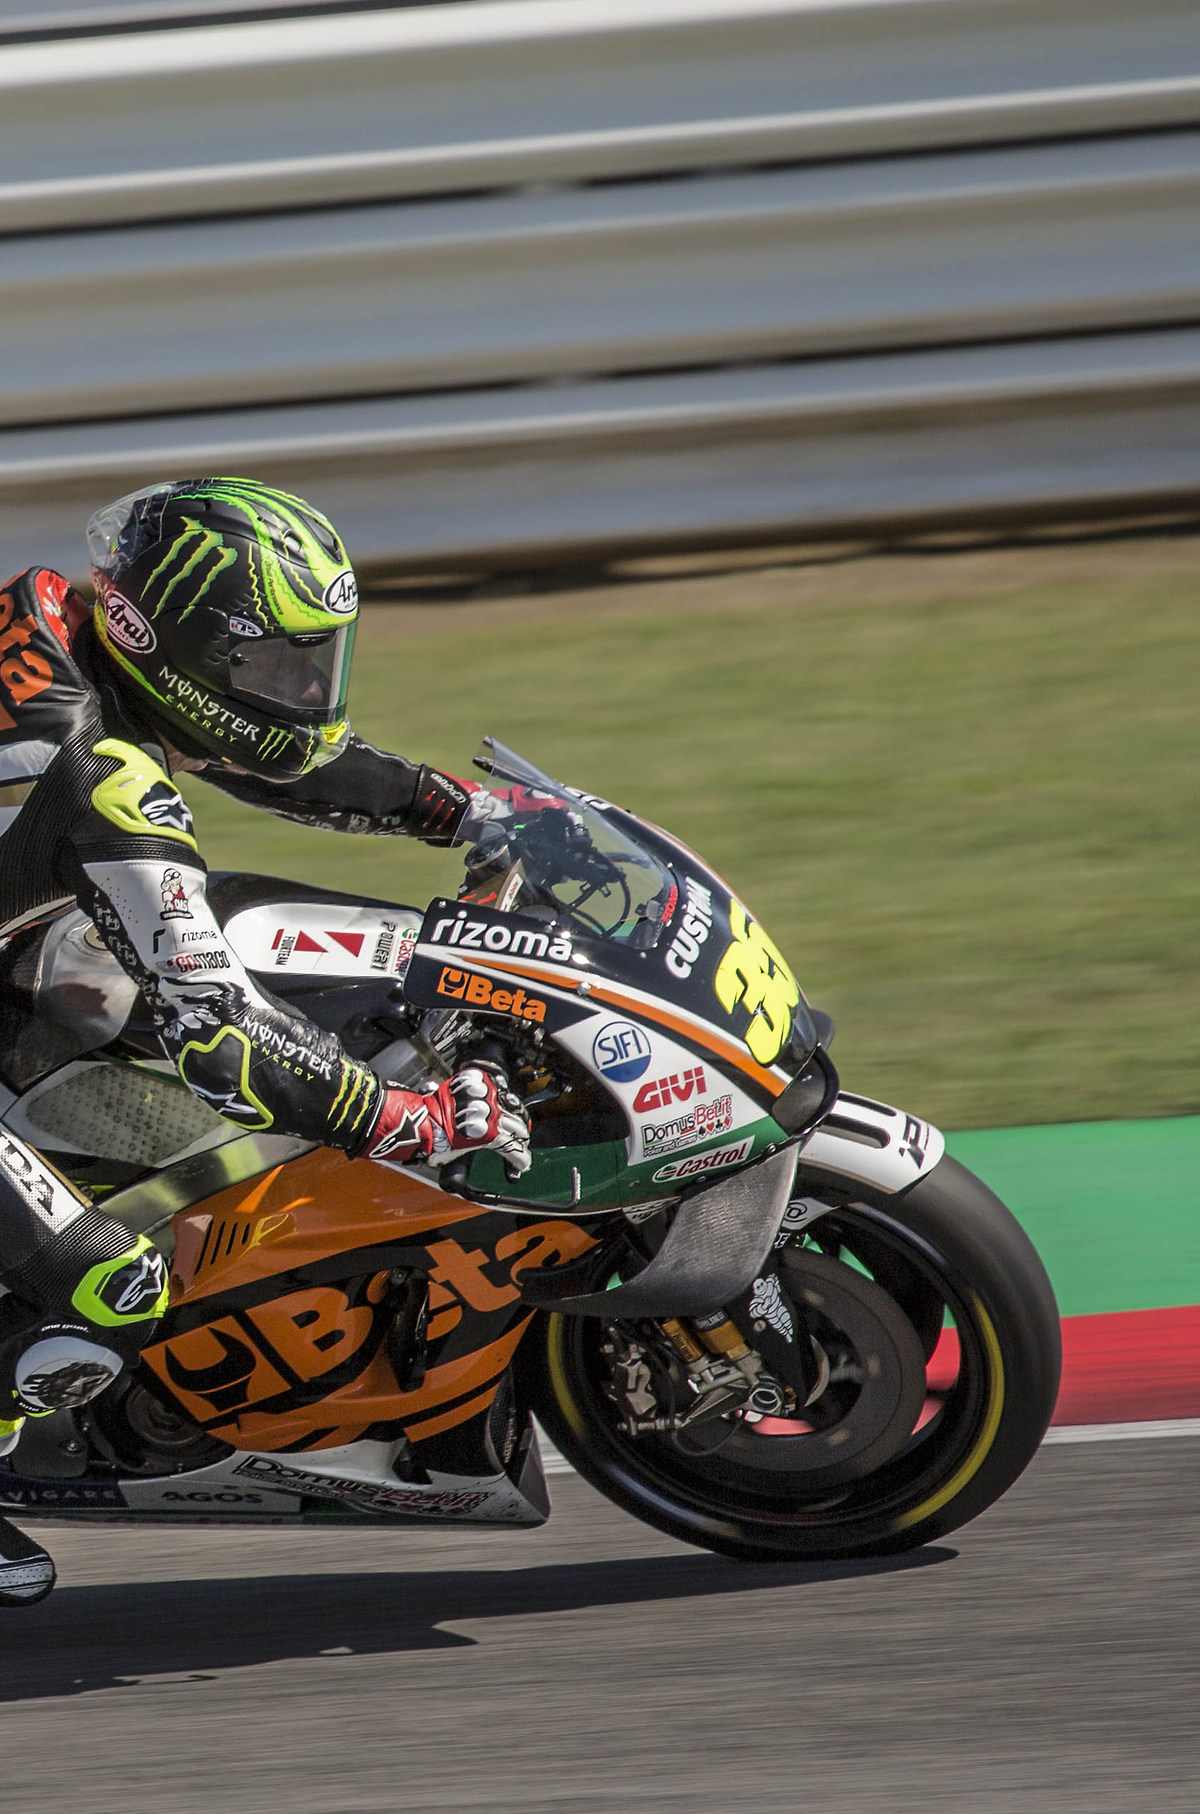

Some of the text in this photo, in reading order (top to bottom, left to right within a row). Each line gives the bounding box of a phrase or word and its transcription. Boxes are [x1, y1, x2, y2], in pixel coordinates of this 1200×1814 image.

[106, 603, 149, 644] Arai
[159, 665, 261, 742] MONSTER
[165, 693, 239, 743] ENERGY
[180, 929, 218, 944] rizoma
[430, 910, 573, 962] rizoma
[465, 975, 546, 1022] Beta
[241, 1016, 333, 1081] MONSTER
[251, 1040, 315, 1081] ENERGY
[599, 1028, 642, 1065] SIFI
[632, 1065, 707, 1113] GIVI
[642, 1096, 731, 1144] DomusBet.it
[675, 1142, 748, 1177] Castrol
[246, 1220, 603, 1384] Beta
